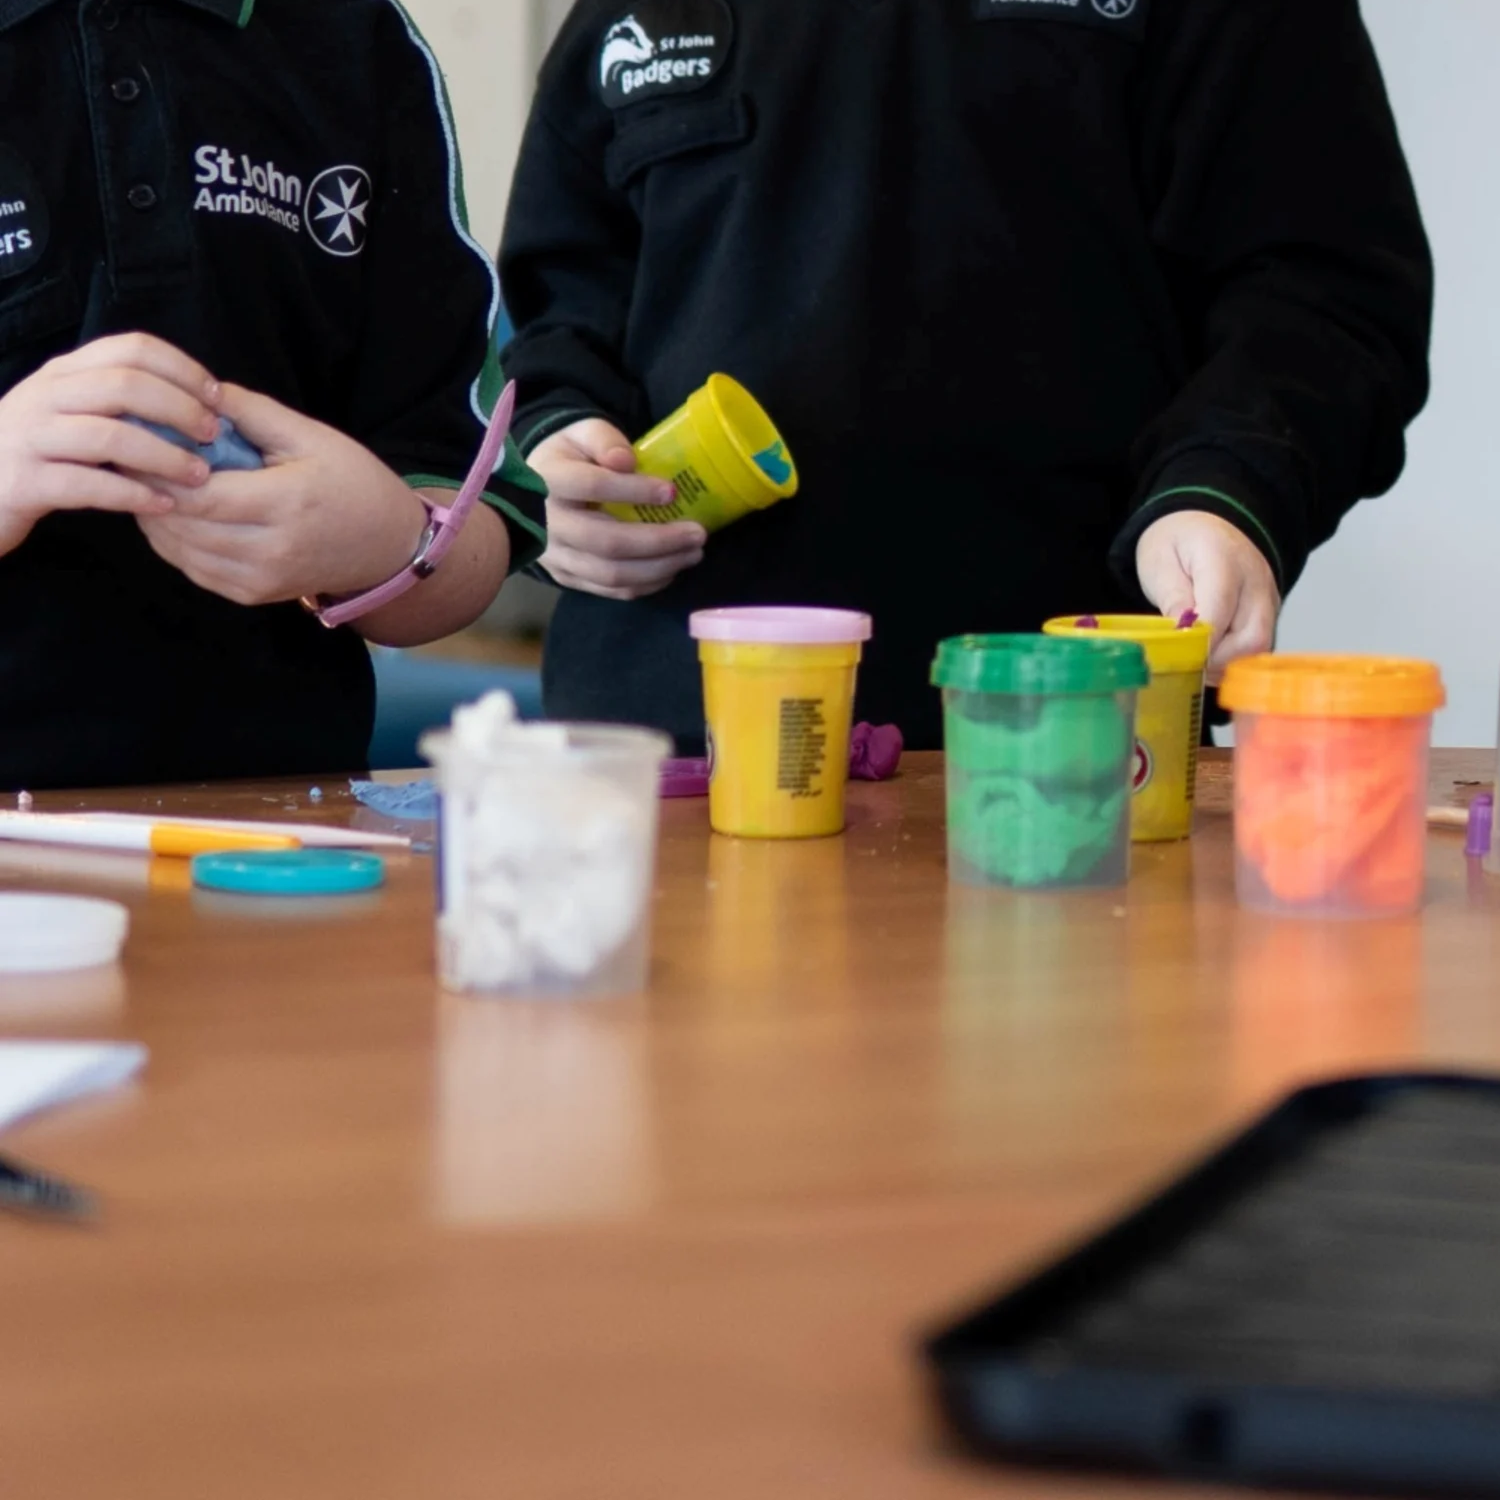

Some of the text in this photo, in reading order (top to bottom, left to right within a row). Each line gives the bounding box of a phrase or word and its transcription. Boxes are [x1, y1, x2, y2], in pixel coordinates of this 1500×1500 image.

[621, 56, 712, 95] Badgers
[194, 144, 302, 206] St John
[0, 199, 26, 217] hn
[193, 187, 300, 233] Ambulance
